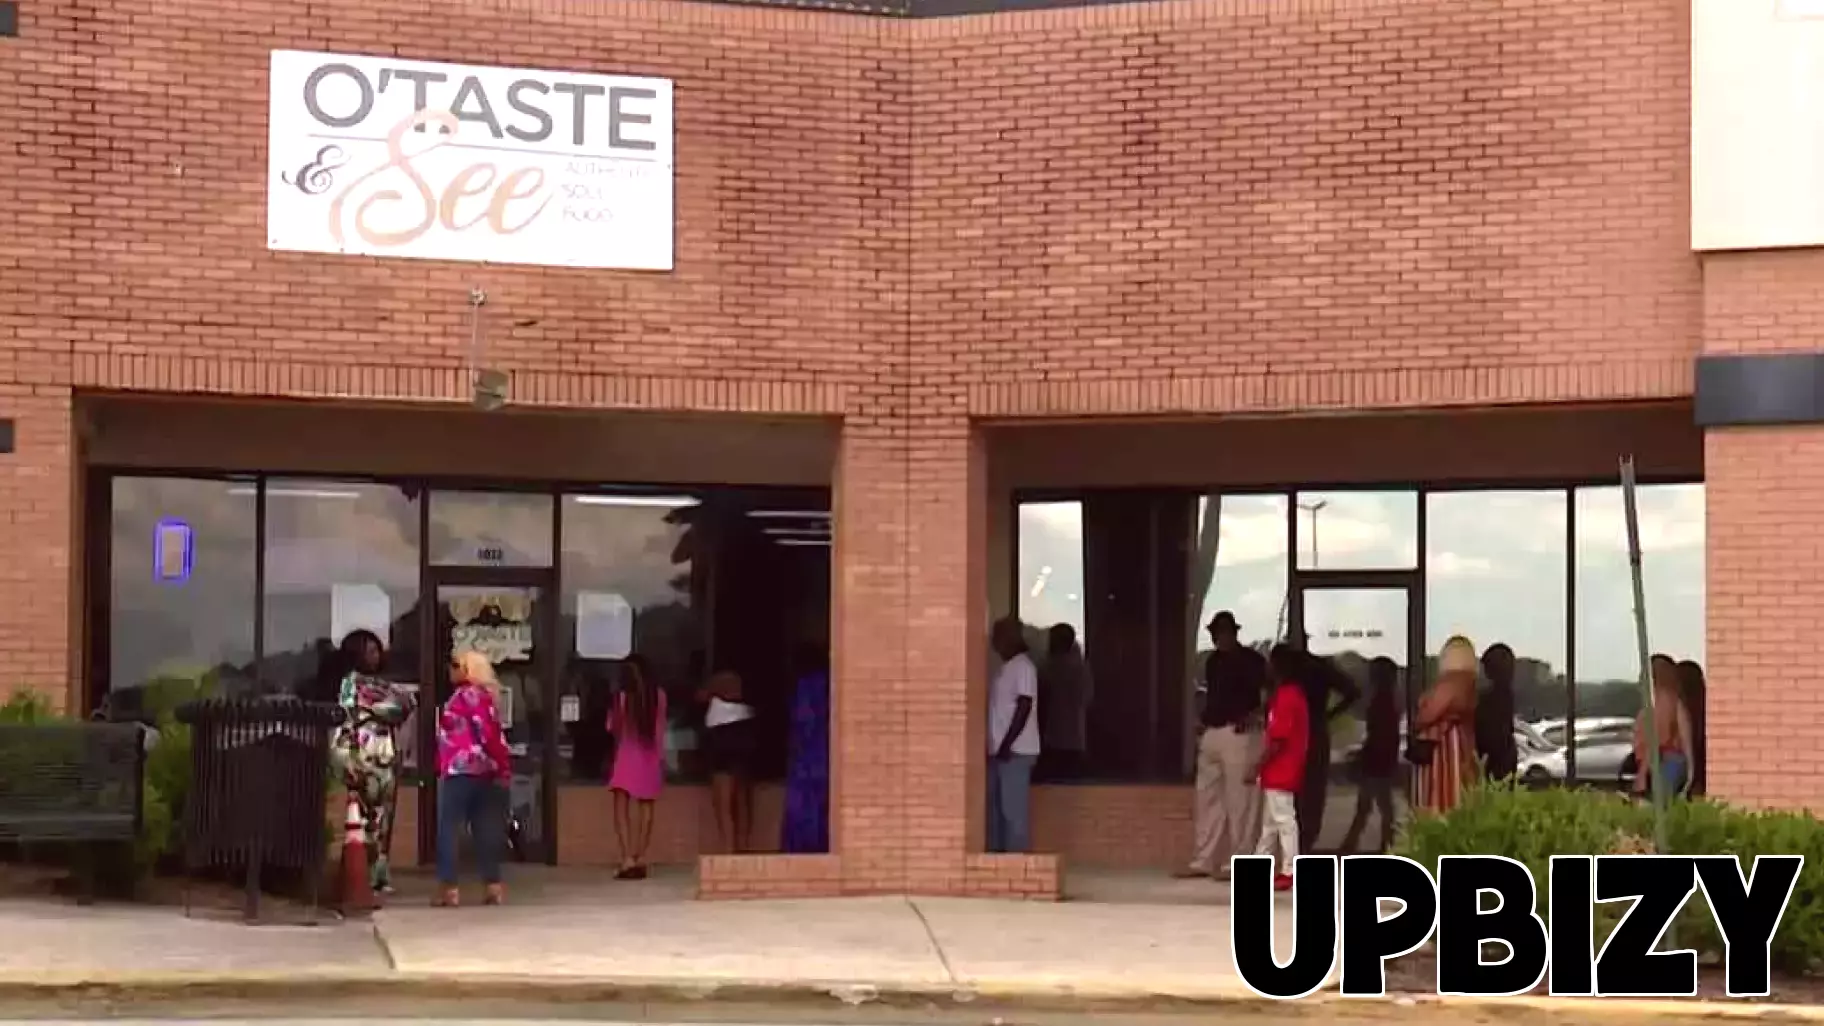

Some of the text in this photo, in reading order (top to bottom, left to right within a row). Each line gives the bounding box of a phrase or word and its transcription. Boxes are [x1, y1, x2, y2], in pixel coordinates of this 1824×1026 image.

[303, 63, 657, 151] O'TASTE
[281, 109, 555, 247] & See
